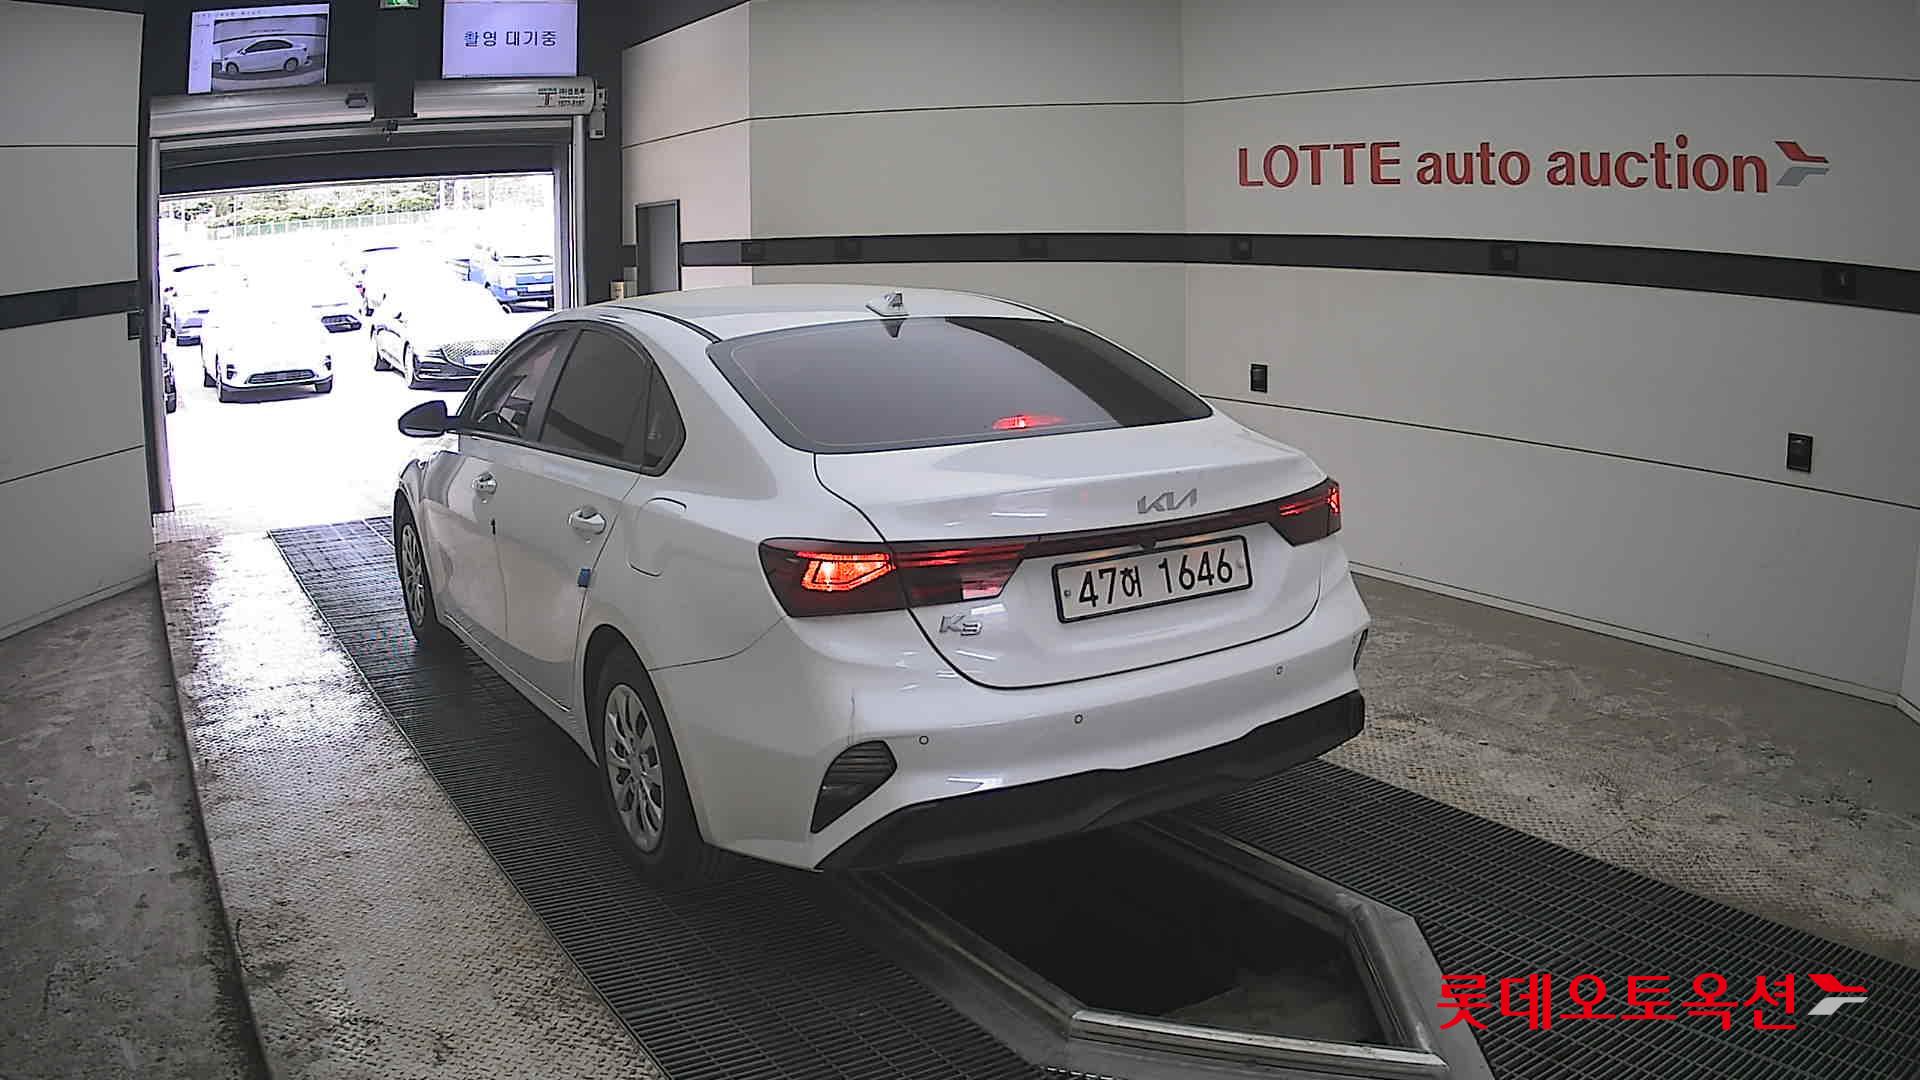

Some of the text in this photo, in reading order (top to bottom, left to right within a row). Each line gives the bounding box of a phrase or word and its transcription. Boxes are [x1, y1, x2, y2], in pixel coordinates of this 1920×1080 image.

[506, 31, 557, 47] 대기중
[1239, 135, 1768, 193] LOTTE auto auction
[1078, 547, 1233, 608] 47허 1646
[939, 614, 983, 637] K3
